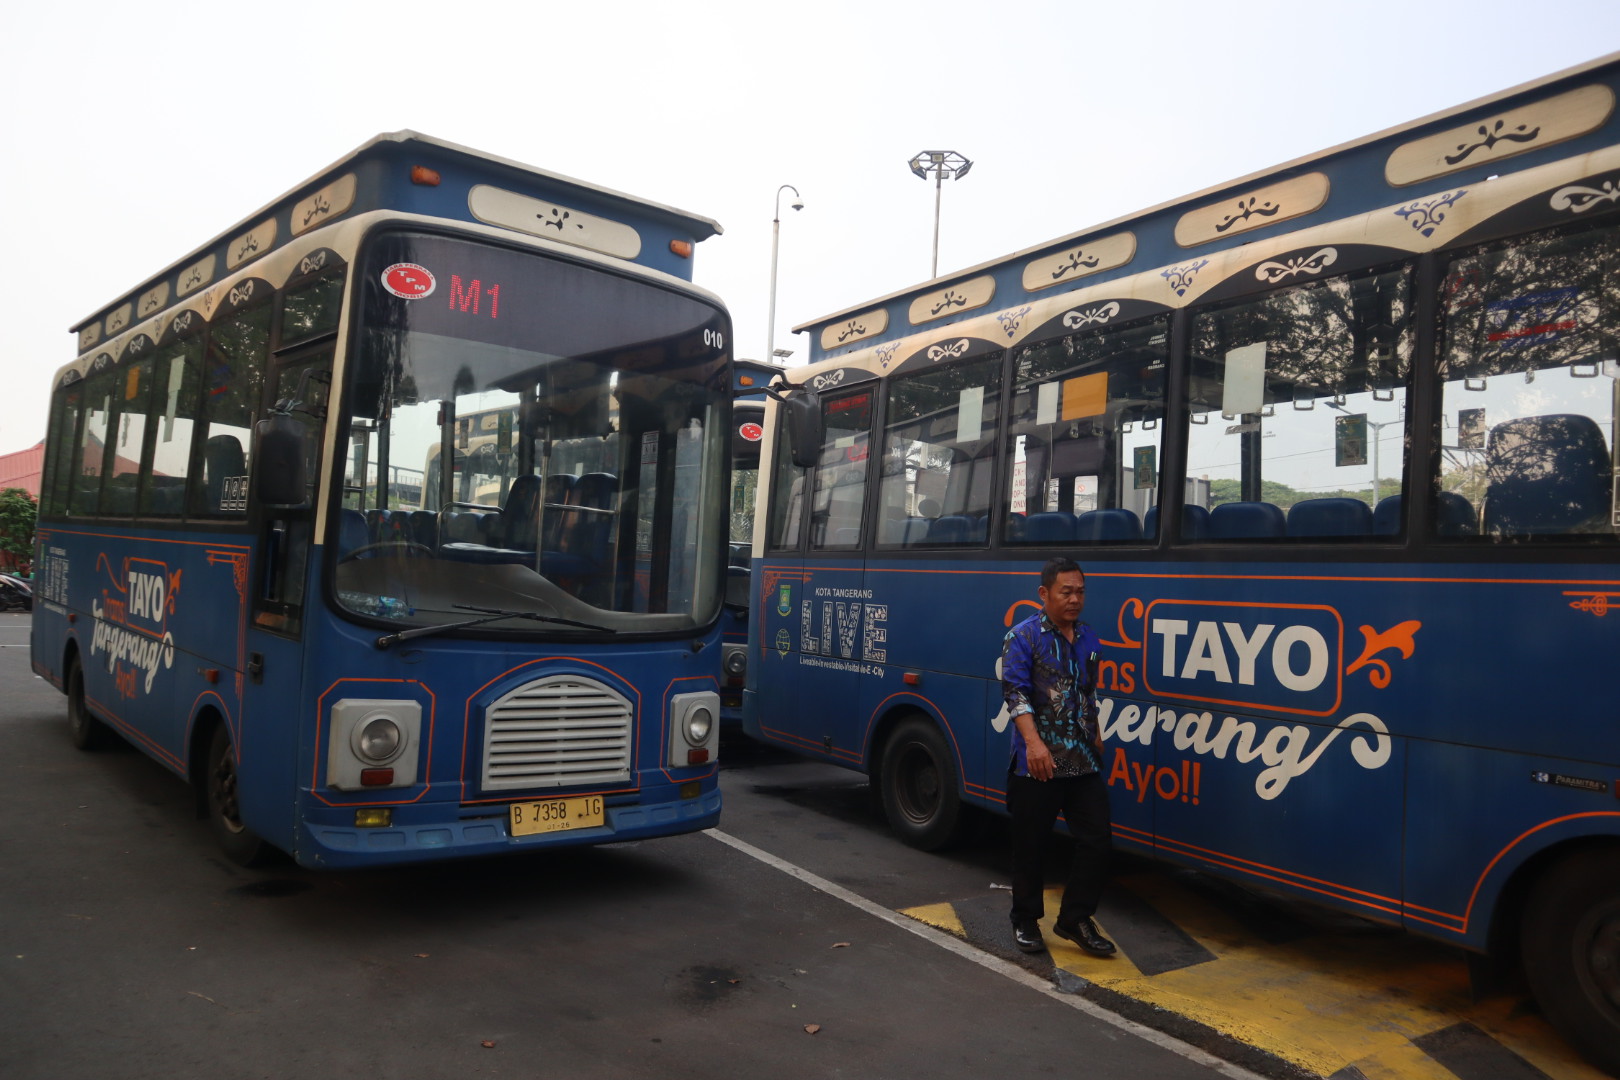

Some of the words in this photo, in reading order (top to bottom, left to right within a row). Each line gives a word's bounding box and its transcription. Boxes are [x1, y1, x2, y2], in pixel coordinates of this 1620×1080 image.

[449, 274, 499, 319] M1
[703, 328, 723, 350] 010
[128, 571, 165, 623] TAYO
[816, 587, 831, 597] KOTA
[833, 588, 873, 599] TANGERANG
[91, 598, 175, 695] Tangerang
[800, 600, 888, 663] LIVE
[1152, 618, 1330, 692] TAYO
[1108, 747, 1200, 806] Ayo!!
[514, 806, 523, 824] B
[533, 802, 567, 822] 7358
